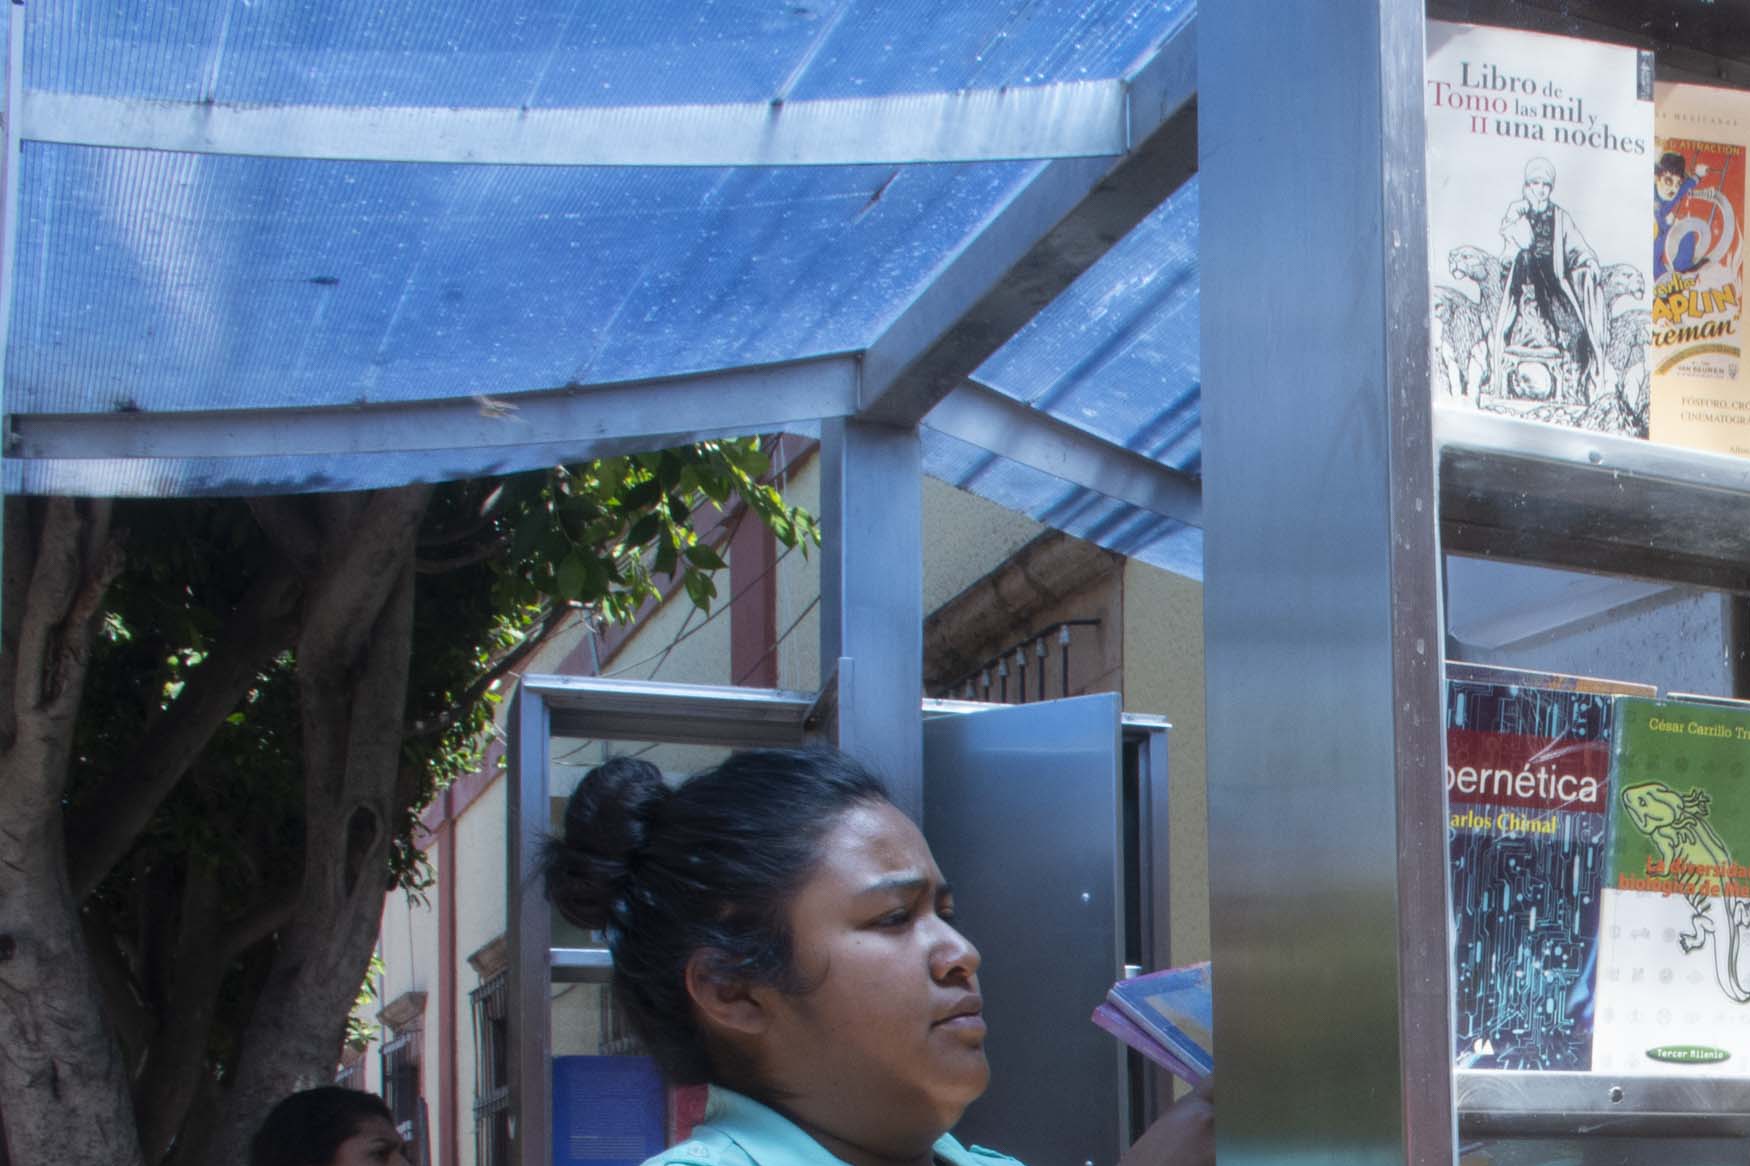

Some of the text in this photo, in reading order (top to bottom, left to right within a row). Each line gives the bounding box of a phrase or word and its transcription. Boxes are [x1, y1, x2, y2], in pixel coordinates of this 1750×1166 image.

[1460, 62, 1562, 99] Libro de
[1428, 80, 1598, 131] Tomo las mil y
[1470, 115, 1488, 134] II
[1496, 119, 1544, 141] una
[1555, 124, 1645, 156] noches
[1649, 717, 1685, 735] César
[1688, 721, 1732, 738] Carrillo
[1497, 811, 1557, 833] Chimal
[1647, 855, 1665, 873] La
[1618, 872, 1696, 897] biológica
[1700, 880, 1720, 896] de
[1657, 1049, 1688, 1059] Tercer
